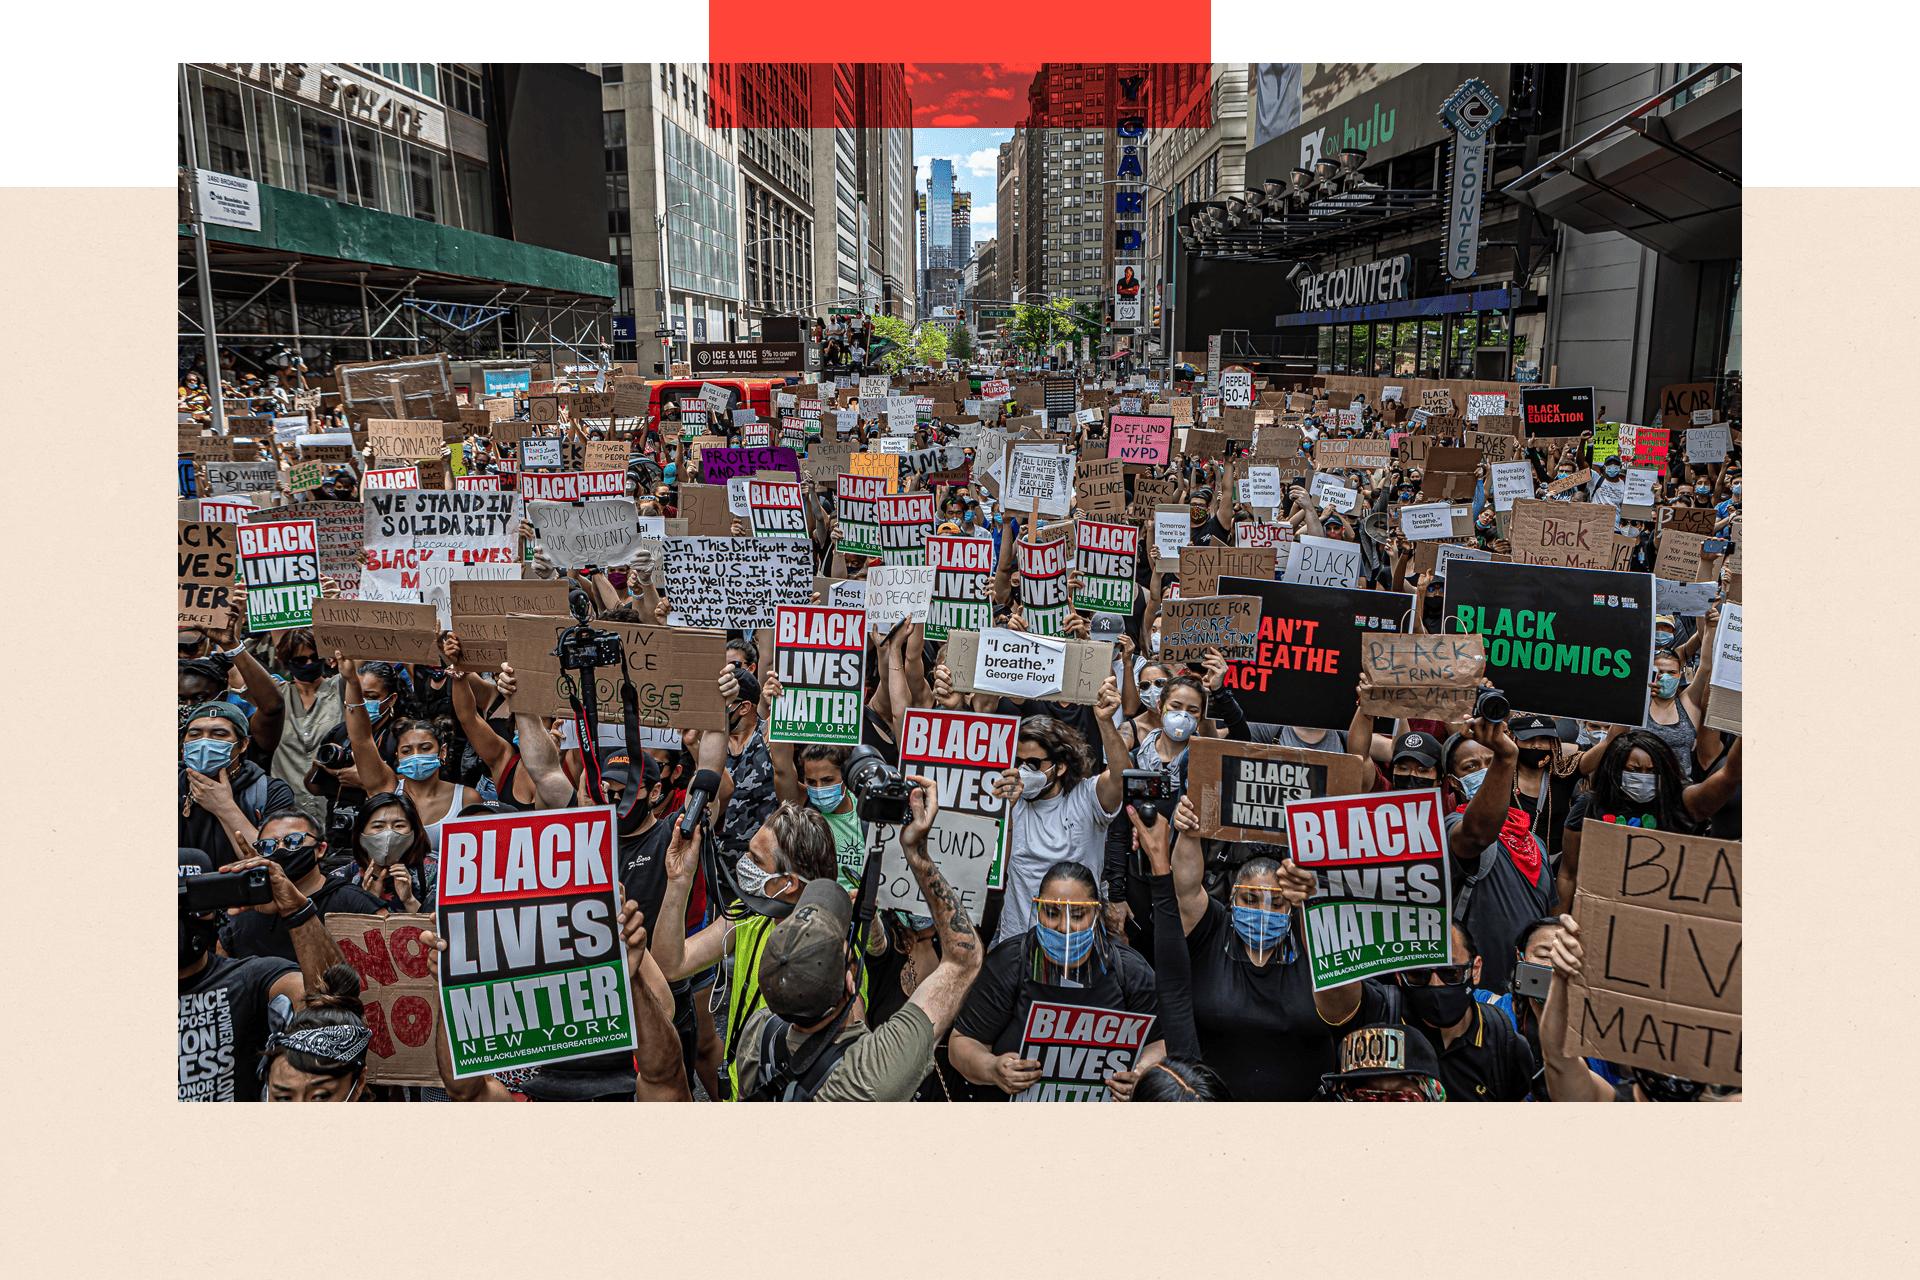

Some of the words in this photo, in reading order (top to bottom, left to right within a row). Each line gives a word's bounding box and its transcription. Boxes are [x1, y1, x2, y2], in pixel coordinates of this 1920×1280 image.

[1449, 85, 1477, 112] CUSTOM
[1479, 88, 1499, 109] BUILT
[1301, 127, 1325, 172] FX
[1326, 134, 1339, 155] ON
[1344, 103, 1396, 150] hulu
[1454, 119, 1492, 138] BURGERS
[1463, 145, 1480, 155] THE
[1455, 157, 1477, 270] COUNTER
[1300, 273, 1324, 311] THE
[1327, 257, 1405, 307] COUNTER
[729, 351, 735, 359] &
[737, 350, 757, 358] VICE
[982, 383, 1010, 394] MURDER
[1225, 375, 1250, 388] REPEAL
[681, 399, 706, 411] BLACK
[1225, 388, 1250, 402] 50-A
[1664, 389, 1711, 416] ACAB
[1528, 404, 1560, 413] BLACK
[1528, 412, 1584, 424] EDUCATION
[371, 422, 389, 435] SAY
[391, 423, 410, 434] HER
[415, 421, 441, 434] NAME
[1114, 423, 1166, 434] DEFUND
[1128, 434, 1150, 444] THE
[1638, 430, 1667, 438] NOTHING
[372, 436, 425, 457] BREONNA
[426, 437, 441, 445] TAY
[817, 444, 854, 455] DEFUND
[1120, 447, 1159, 459] NYPD
[1021, 465, 1036, 473] CAN'T
[1036, 466, 1056, 474] MATTER
[1022, 457, 1036, 466] ALL
[1037, 458, 1057, 467] LIVES
[1077, 461, 1120, 479] WHITE
[209, 469, 238, 483] END
[241, 469, 276, 482] WHITE
[227, 481, 273, 492] SILENCE
[522, 476, 577, 500] BLACK
[579, 473, 624, 492] BLACK
[839, 474, 887, 498] BLACK
[1019, 479, 1036, 488] BLACK
[1038, 481, 1054, 489] LIVES
[1137, 481, 1169, 495] BLACK
[751, 483, 801, 508] BLACK
[1018, 486, 1054, 498] MATTER
[1078, 480, 1124, 498] SILENCE
[1324, 489, 1346, 499] Denial
[371, 494, 406, 516] WE
[416, 494, 484, 513] STAND
[485, 493, 513, 513] IN
[878, 496, 933, 522] BLACK
[1330, 497, 1352, 507] Racist
[381, 514, 511, 537] SOLIDARITY
[538, 507, 570, 529] STOP
[579, 505, 626, 528] KILLING
[754, 508, 805, 531] LIVES
[1159, 522, 1187, 530] Tomorrow
[239, 525, 315, 555] BLACK
[547, 535, 568, 551] OUR
[575, 527, 632, 551] STUDENTS
[1079, 523, 1134, 552] BLACK
[1239, 524, 1294, 543] JUSTICE
[1540, 519, 1591, 551] Black
[366, 550, 433, 571] BLACK
[927, 542, 990, 569] BLACK
[1019, 543, 1066, 575] BLACK
[1078, 550, 1133, 577] LIVES
[1182, 552, 1216, 576] SAY
[1223, 553, 1267, 576] THEIR
[1300, 545, 1356, 578] BLACK
[245, 557, 317, 586] LIVES
[870, 570, 884, 588] NO
[887, 568, 932, 586] JUSTICE
[932, 572, 987, 599] LIVES
[1022, 577, 1067, 605] LIVES
[1079, 577, 1132, 602] MATTER
[249, 585, 319, 616] MATTER
[869, 593, 882, 606] NO
[1076, 595, 1095, 604] NEW
[1102, 599, 1129, 607] YORK
[1167, 603, 1221, 617] JUSTICE
[1228, 602, 1250, 615] FOR
[321, 608, 362, 623] LATINX
[372, 611, 415, 626] STANDS
[927, 603, 989, 627] MATTER
[1182, 616, 1238, 633] GEORGE,
[1456, 604, 1556, 640] BLACK
[779, 611, 863, 646] BLACK
[1257, 616, 1319, 645] AN'T
[355, 634, 401, 651] BLM
[987, 639, 999, 652] "I
[1164, 647, 1207, 662] BLACK
[779, 650, 860, 686] LIVES
[1257, 642, 1340, 674] EATHE
[1370, 642, 1473, 671] BLACK
[1483, 637, 1632, 678] CONOMICS
[986, 669, 1024, 682] George
[1026, 672, 1055, 683] Floyd
[1223, 665, 1273, 692] ACT
[1390, 664, 1454, 685] TRANS
[1369, 687, 1418, 700] LIVES
[1426, 686, 1477, 701] MATTE
[774, 689, 858, 725] MATTER
[775, 721, 807, 732] NEW
[815, 722, 855, 733] YORK
[905, 715, 1013, 764] BLACK
[1239, 759, 1310, 787] BLACK
[905, 765, 1006, 812] LIVES
[1236, 782, 1303, 803] LIVES
[1231, 804, 1286, 829] MATT
[1292, 800, 1439, 863] BLACK
[444, 819, 609, 898] BLACK
[1315, 863, 1442, 904] LIVES
[447, 900, 613, 977] LIVES
[1307, 905, 1442, 959] MATTER
[337, 926, 430, 991] NO
[1316, 952, 1445, 981] WWW.BLACKLIVESMATTERGREATERNY.COM
[1318, 948, 1361, 971] NEW
[1375, 941, 1439, 957] YORK
[448, 965, 622, 1042] MATTER
[216, 1005, 234, 1046] POWER
[462, 1032, 523, 1055] NEW
[541, 1017, 621, 1043] YORK
[1030, 1008, 1148, 1046] BLACK
[458, 1032, 629, 1067] WWW.BLACKLIVESMATTERGREATERNY.COM
[1342, 1032, 1398, 1065] HOOD
[1028, 1047, 1132, 1080] LIVES
